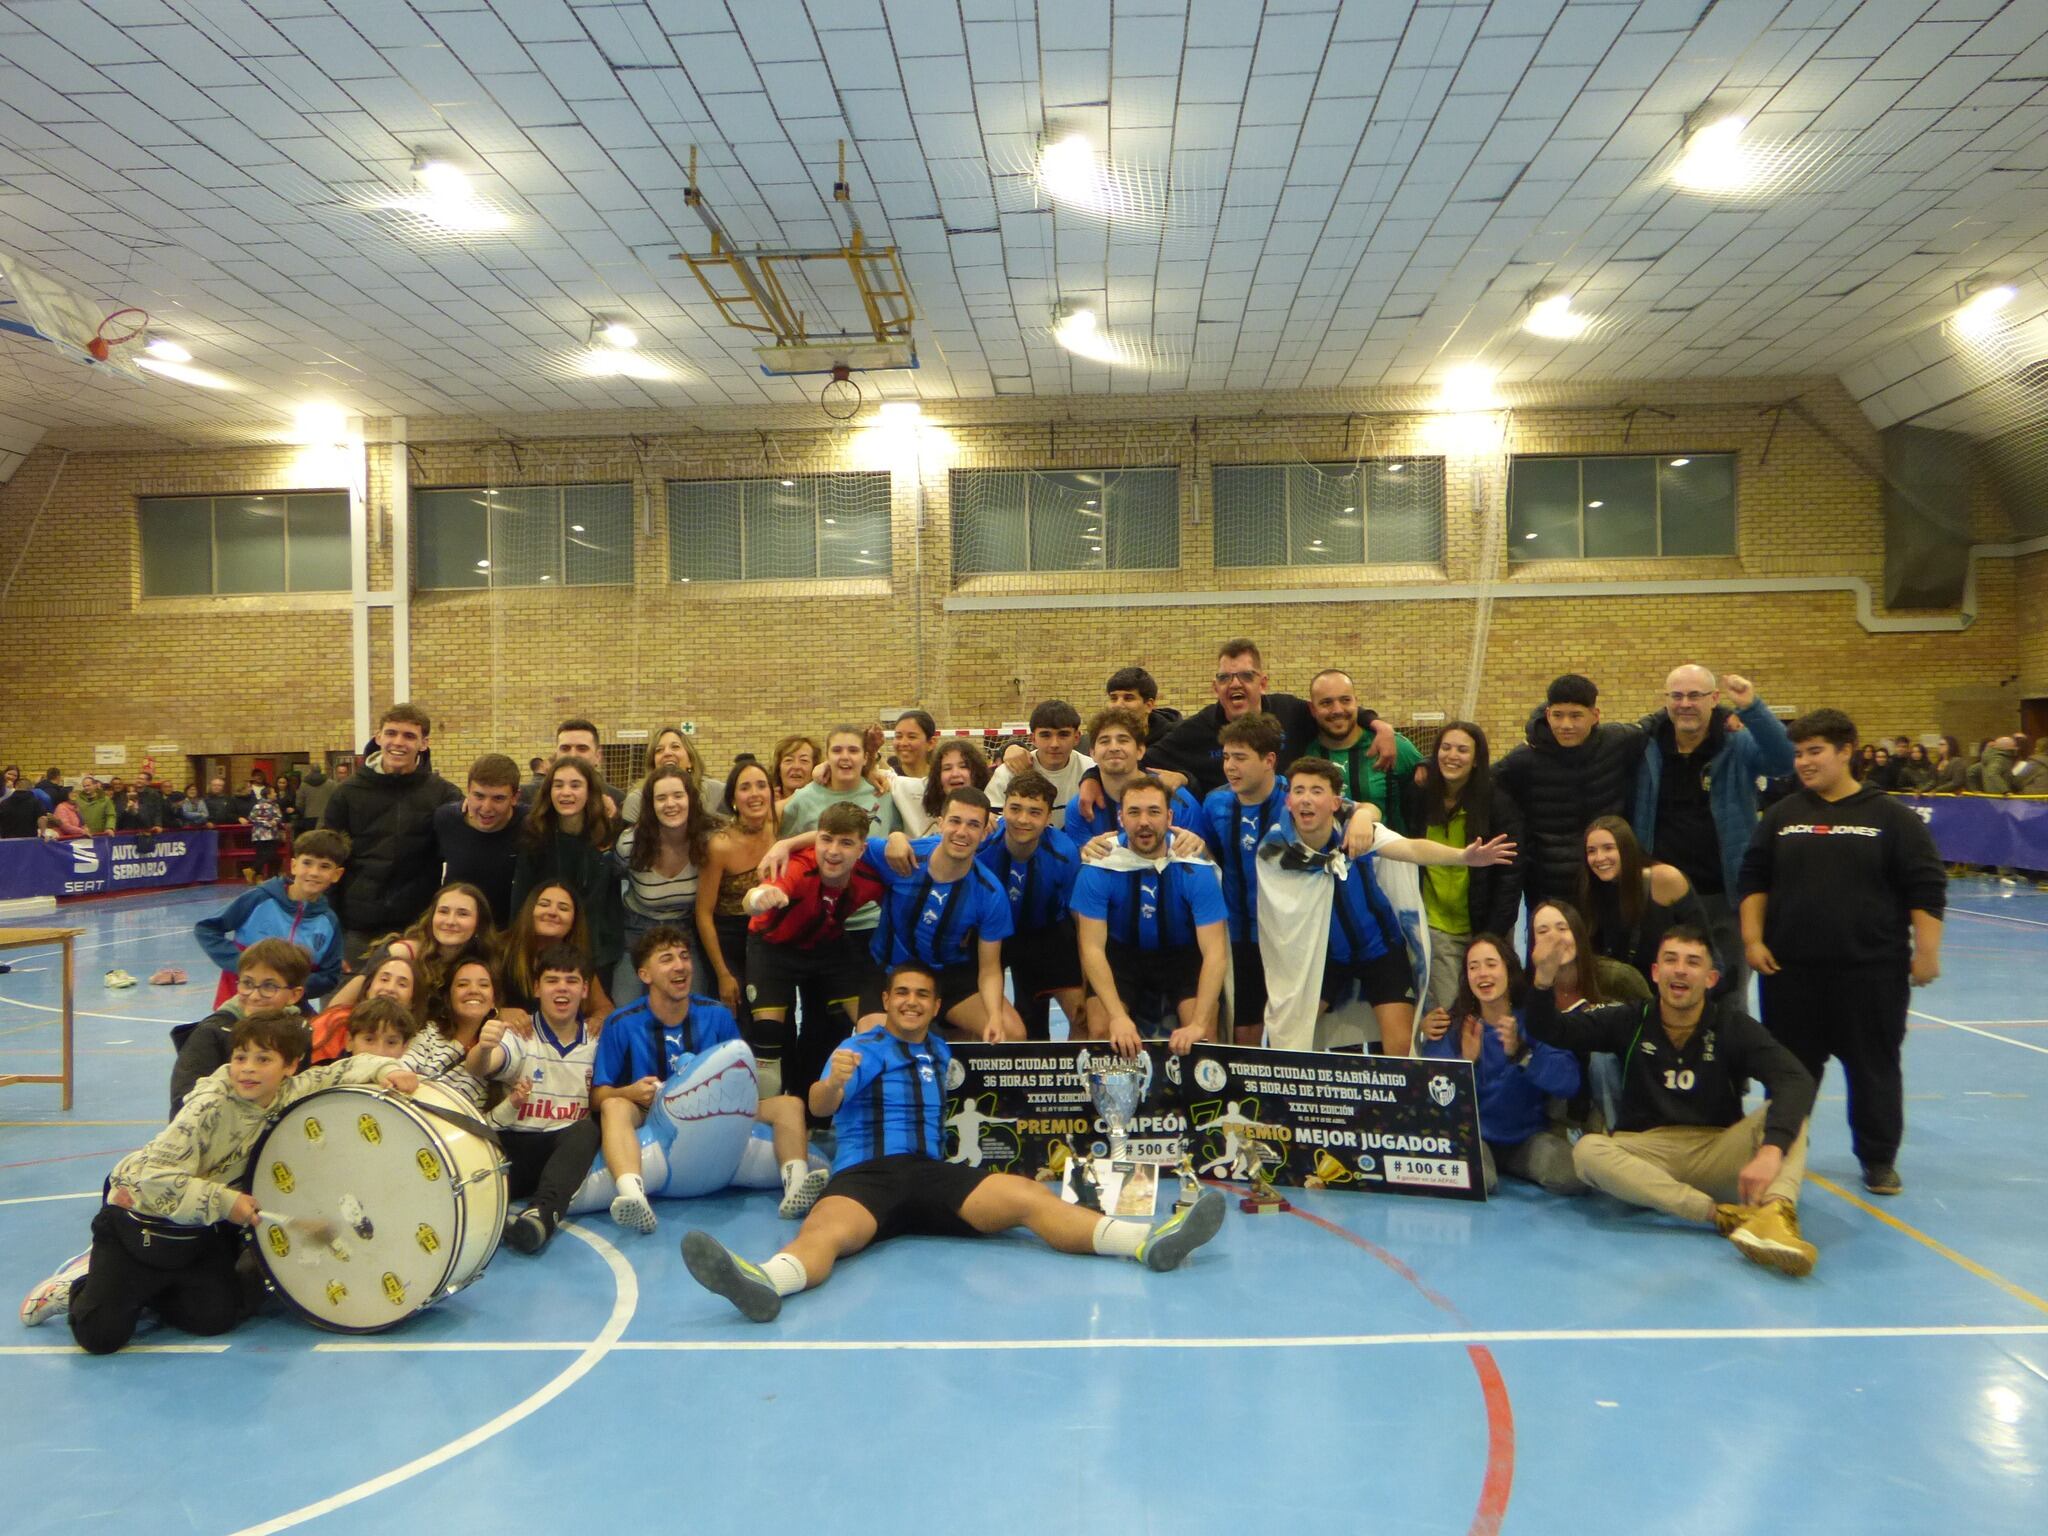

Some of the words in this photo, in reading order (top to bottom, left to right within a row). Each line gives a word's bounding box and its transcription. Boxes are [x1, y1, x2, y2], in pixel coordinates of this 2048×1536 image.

[1778, 824, 1814, 836] JACK
[1828, 825, 1879, 837] JONES
[112, 841, 186, 861] AUTOVILES
[113, 861, 167, 880] SERRABLO
[64, 880, 105, 893] SEAT
[968, 1058, 1013, 1071] TORNEO
[1014, 1058, 1057, 1071] CIUDAD
[1059, 1058, 1074, 1070] DE
[983, 1075, 997, 1087] 36
[999, 1075, 1037, 1087] HORAS
[1038, 1075, 1054, 1087] DE
[1056, 1073, 1087, 1086] FÚT
[1228, 1063, 1272, 1077] TORNEO
[1273, 1067, 1316, 1081] CIUDAD
[1318, 1069, 1334, 1082] DE
[1335, 1070, 1407, 1087] SABIÑÁNIGO
[1663, 1069, 1695, 1090] 10
[1027, 1093, 1057, 1103] XXXVI
[1058, 1092, 1092, 1103] EDICIÓN
[1244, 1080, 1258, 1093] 36
[1259, 1081, 1297, 1096] HORAS
[1298, 1085, 1314, 1097] DE
[1315, 1084, 1362, 1100] FÚTBOL
[1363, 1089, 1397, 1103] SALA
[1288, 1102, 1319, 1114] XXXVI
[1320, 1104, 1354, 1116] EDICIÓN
[1016, 1118, 1088, 1135] PREMIO
[1094, 1113, 1188, 1132] CMPEÓN
[1295, 1127, 1358, 1148] MEJOR
[1361, 1132, 1453, 1154] JUGADOR
[1137, 1143, 1162, 1156] 500
[1166, 1142, 1176, 1155] €
[1406, 1162, 1433, 1174] 100
[1437, 1163, 1448, 1176] €
